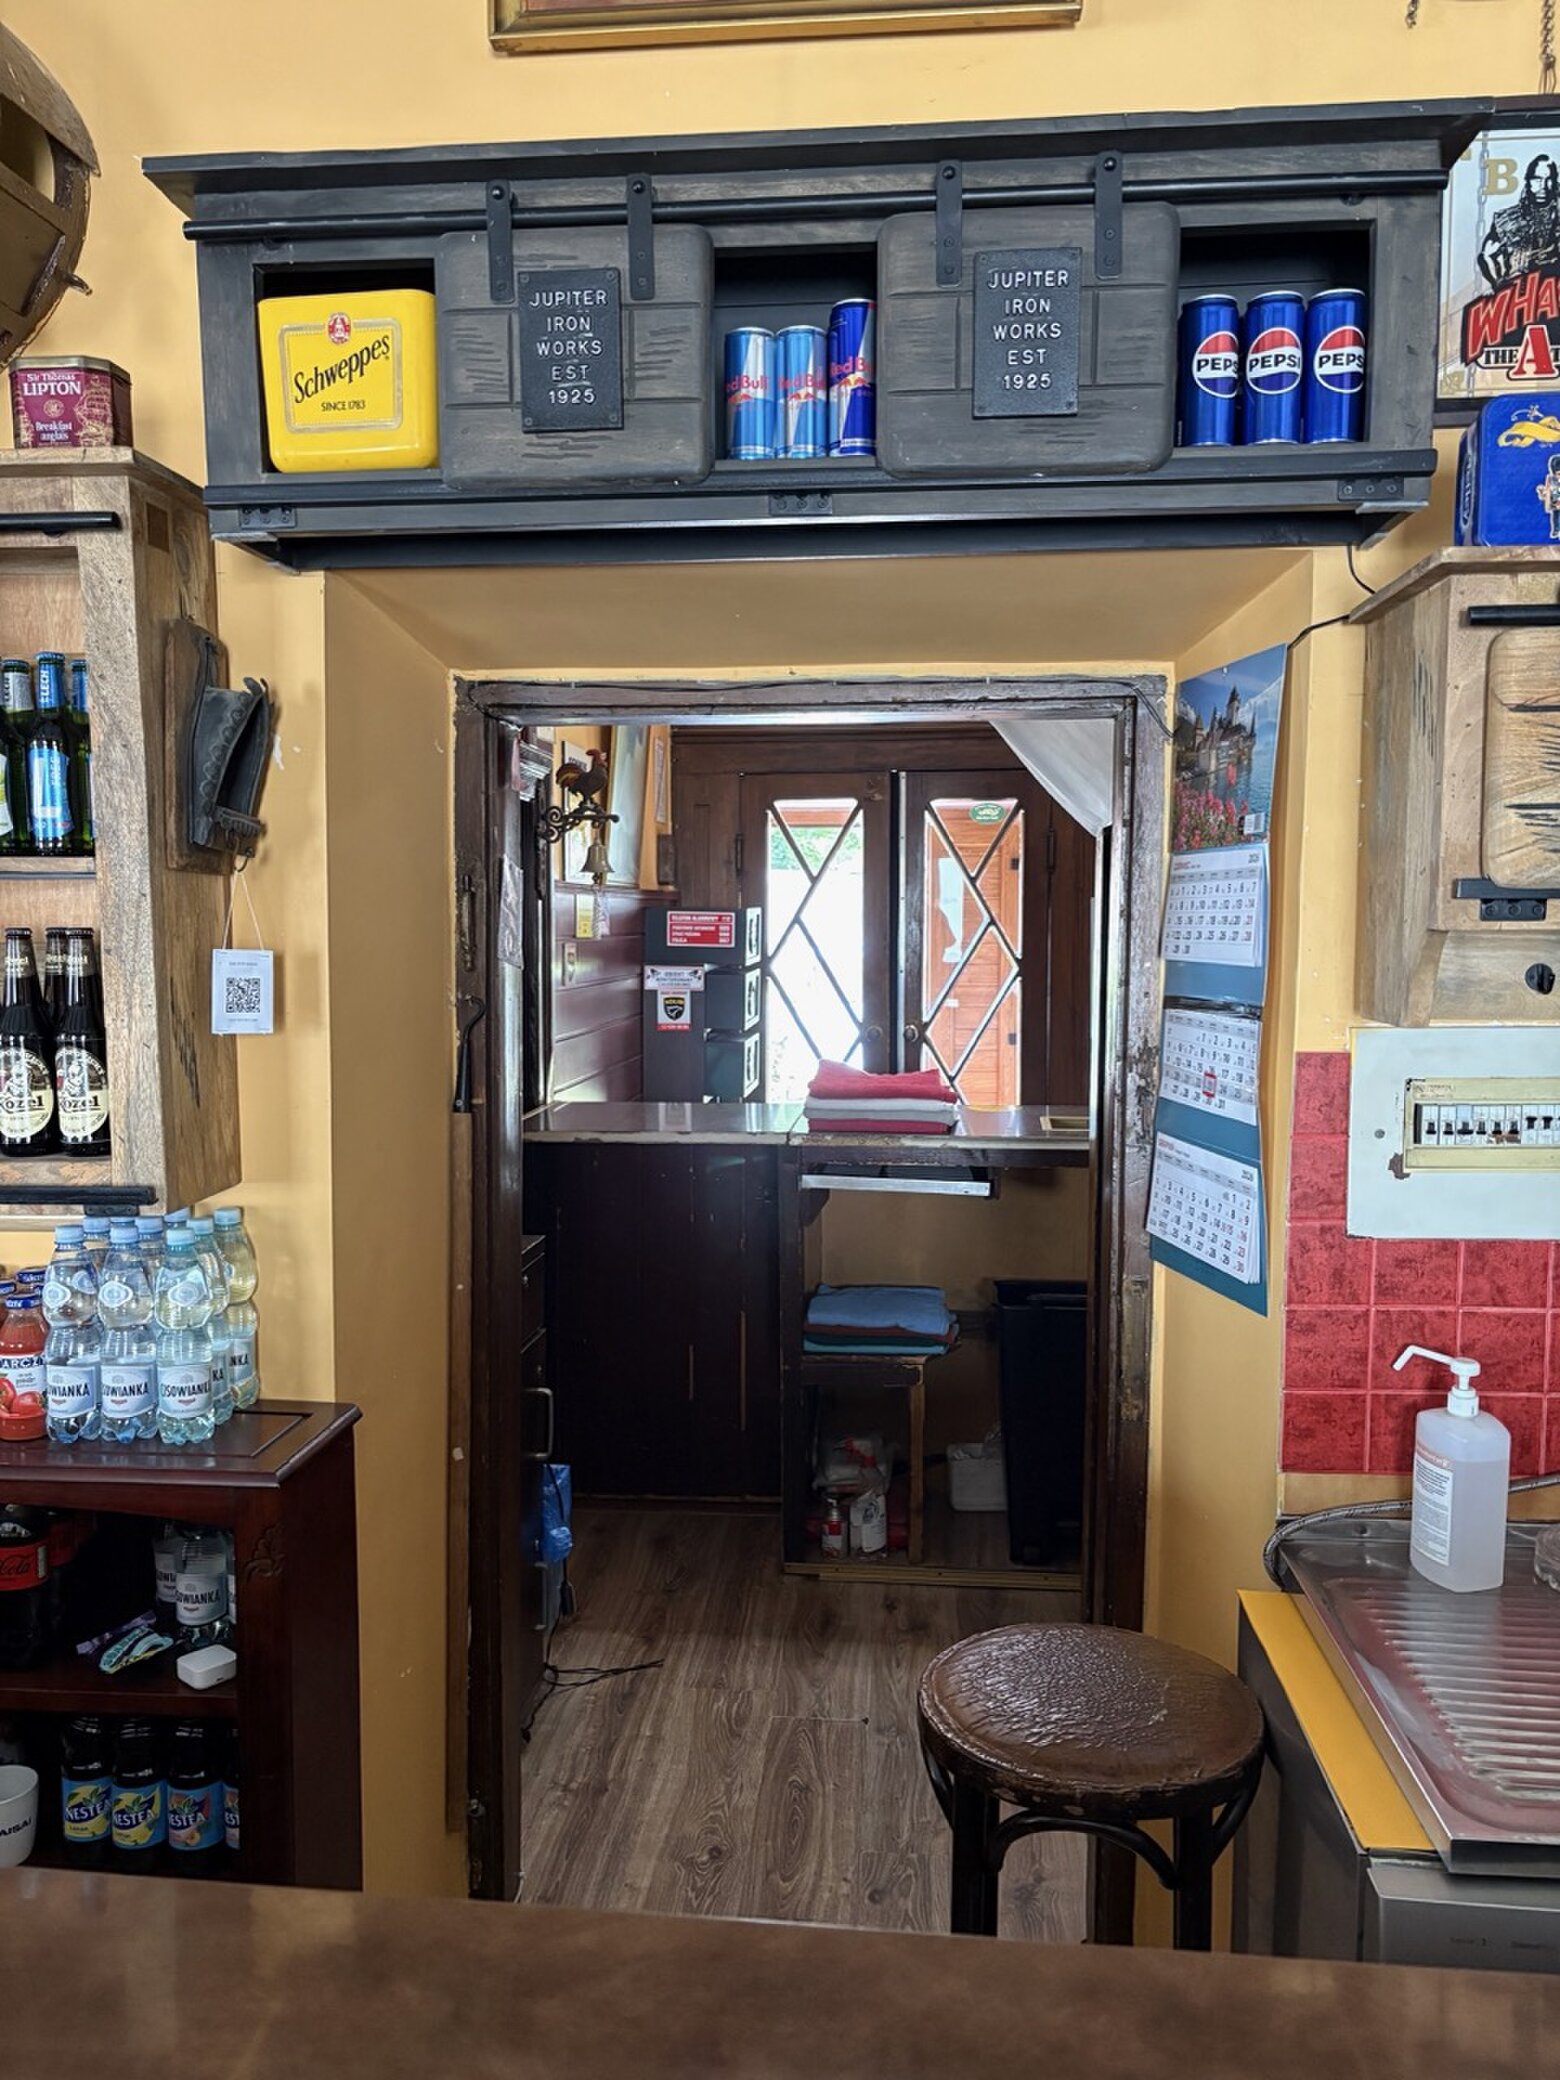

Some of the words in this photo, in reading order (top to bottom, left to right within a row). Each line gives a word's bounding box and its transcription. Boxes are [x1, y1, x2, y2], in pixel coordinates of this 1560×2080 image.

[988, 269, 1069, 289] JUPITER
[529, 289, 608, 308] JUPITER
[1005, 298, 1051, 315] IRON
[546, 315, 592, 333] IRON
[1466, 272, 1560, 360] WHA
[993, 322, 1062, 341] WORKS
[536, 339, 603, 357] WORKS
[1007, 348, 1047, 366] EST
[26, 373, 40, 381] Sir
[42, 372, 76, 381] Thomas
[294, 334, 390, 404] Schweppes
[551, 364, 590, 381] EST
[22, 381, 82, 396] LIPTON
[1003, 373, 1052, 390] 1925
[549, 388, 596, 405] 1925
[321, 401, 346, 412] SINCE
